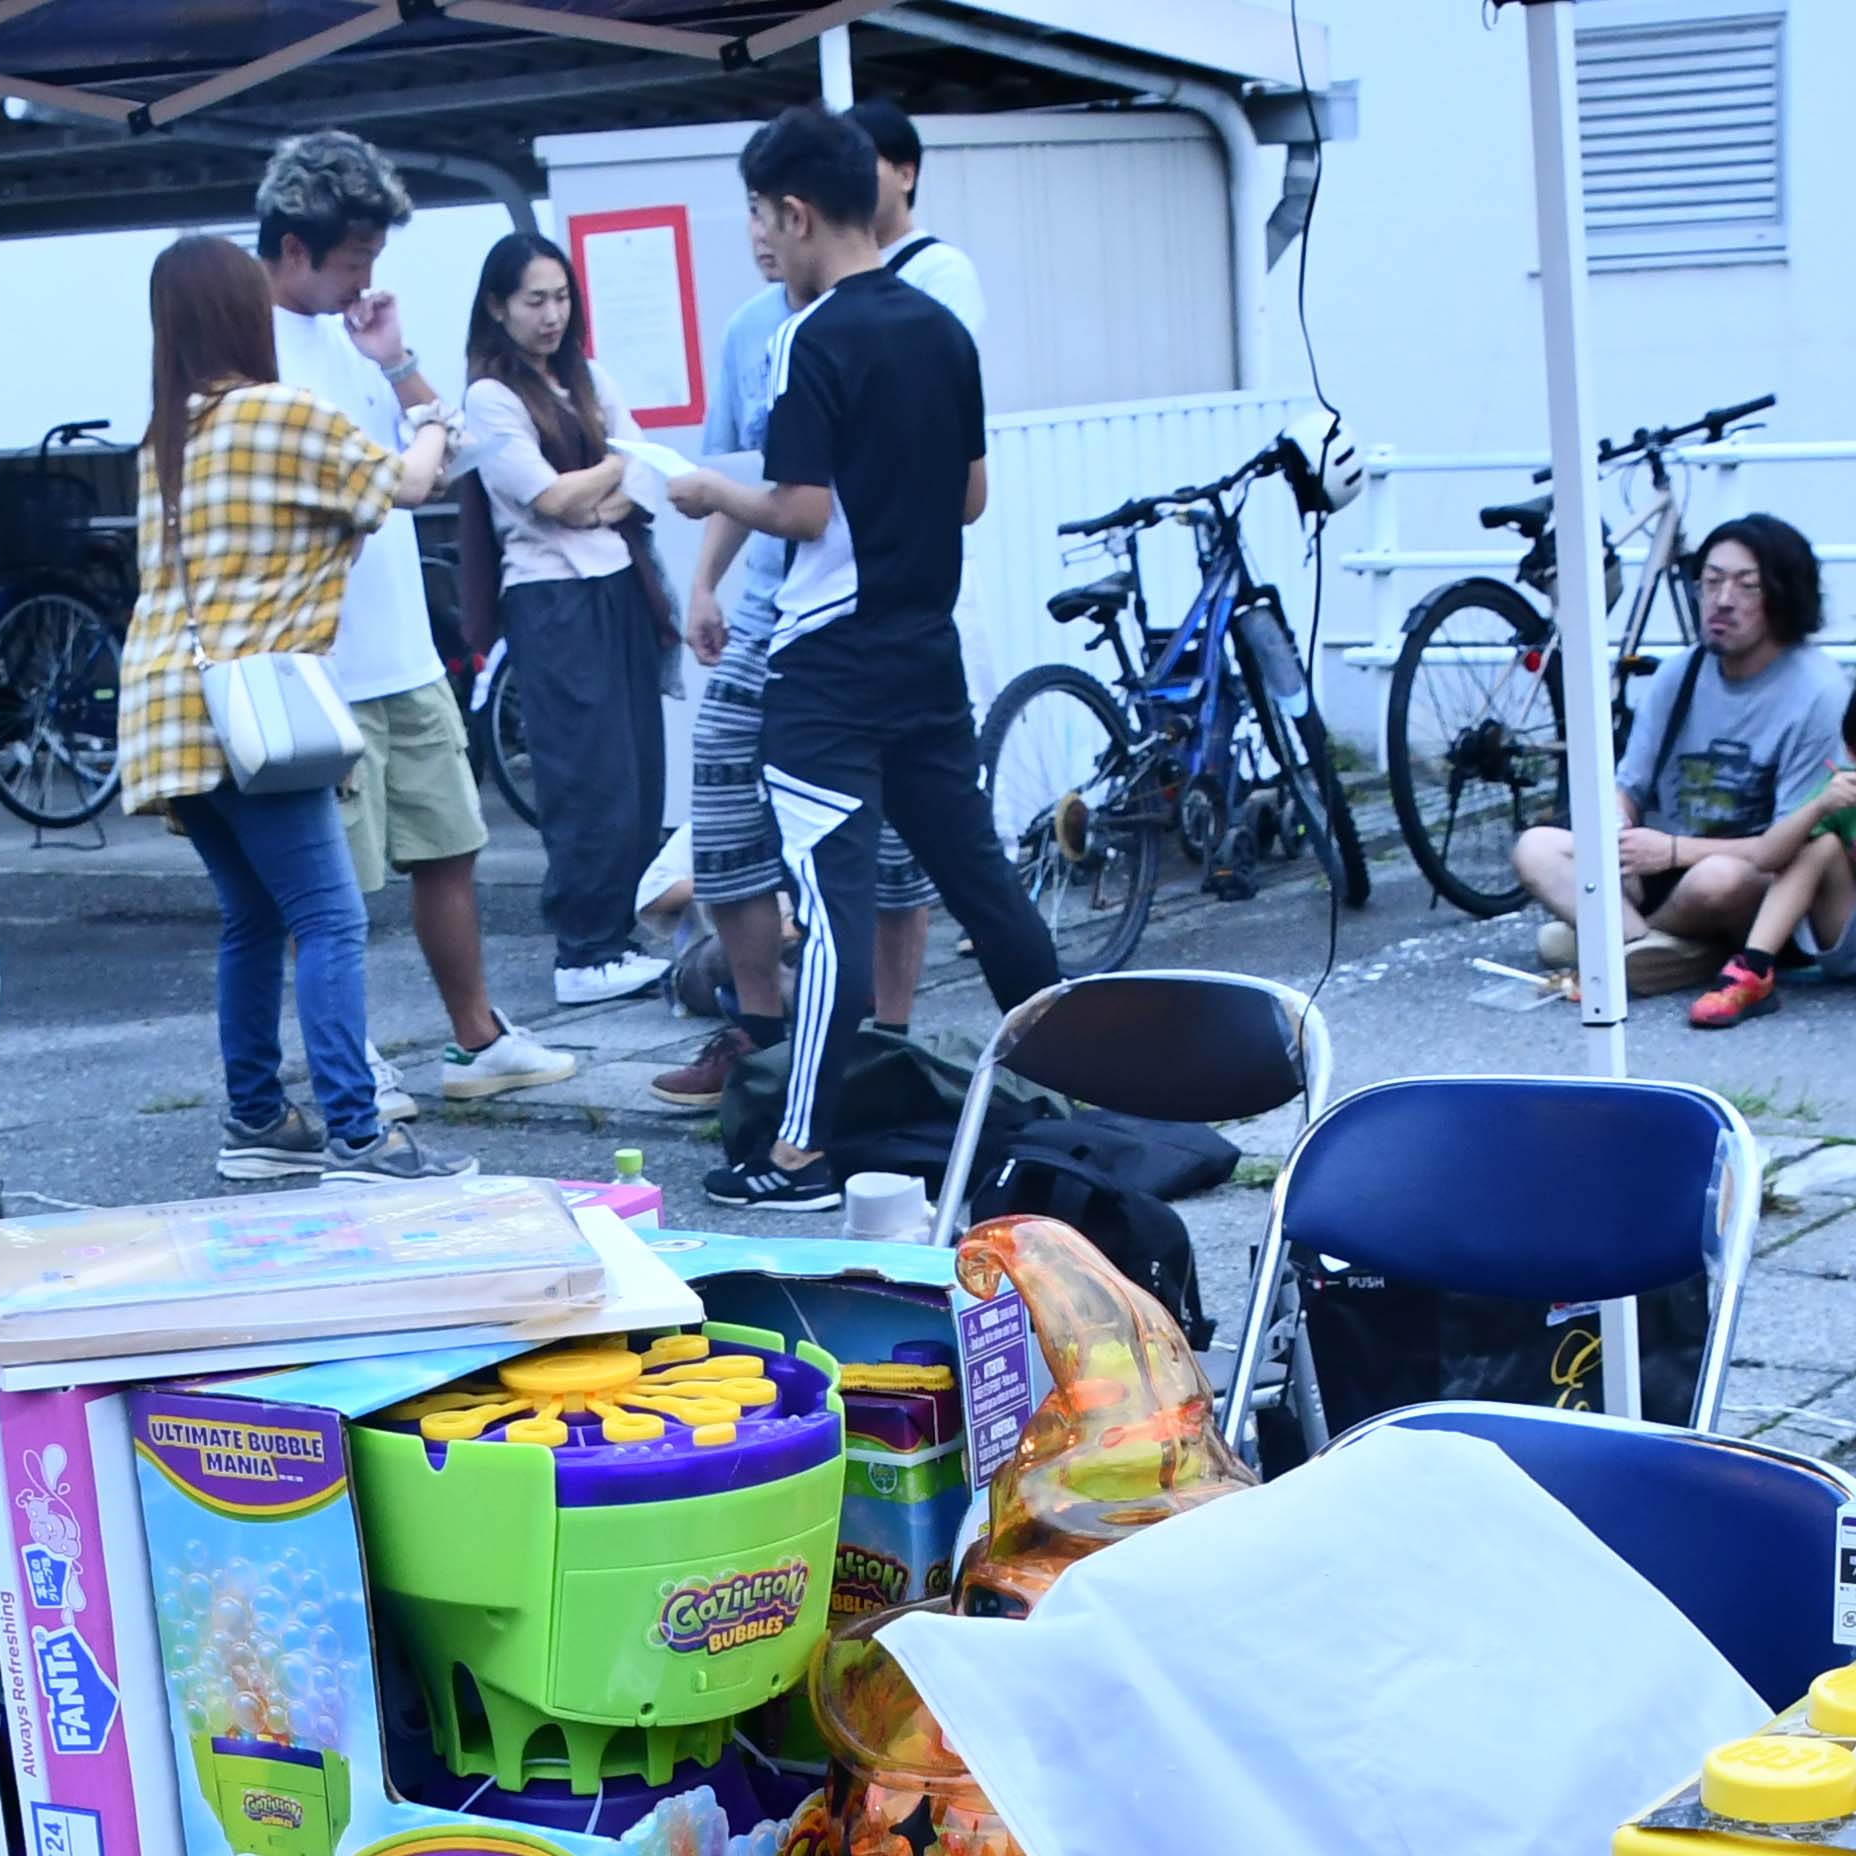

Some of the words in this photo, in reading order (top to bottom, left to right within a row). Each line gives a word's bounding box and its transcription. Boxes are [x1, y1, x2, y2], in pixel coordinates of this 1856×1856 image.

[1347, 1276, 1386, 1290] PUSH
[149, 1420, 245, 1451] ULTIMATE
[247, 1429, 325, 1460] BUBBLE
[206, 1453, 277, 1481] MANIA
[1, 1590, 29, 1702] Refreshing
[709, 1614, 784, 1654] BUBBLES
[40, 1638, 92, 1746] FANTA
[12, 1703, 37, 1778] Always
